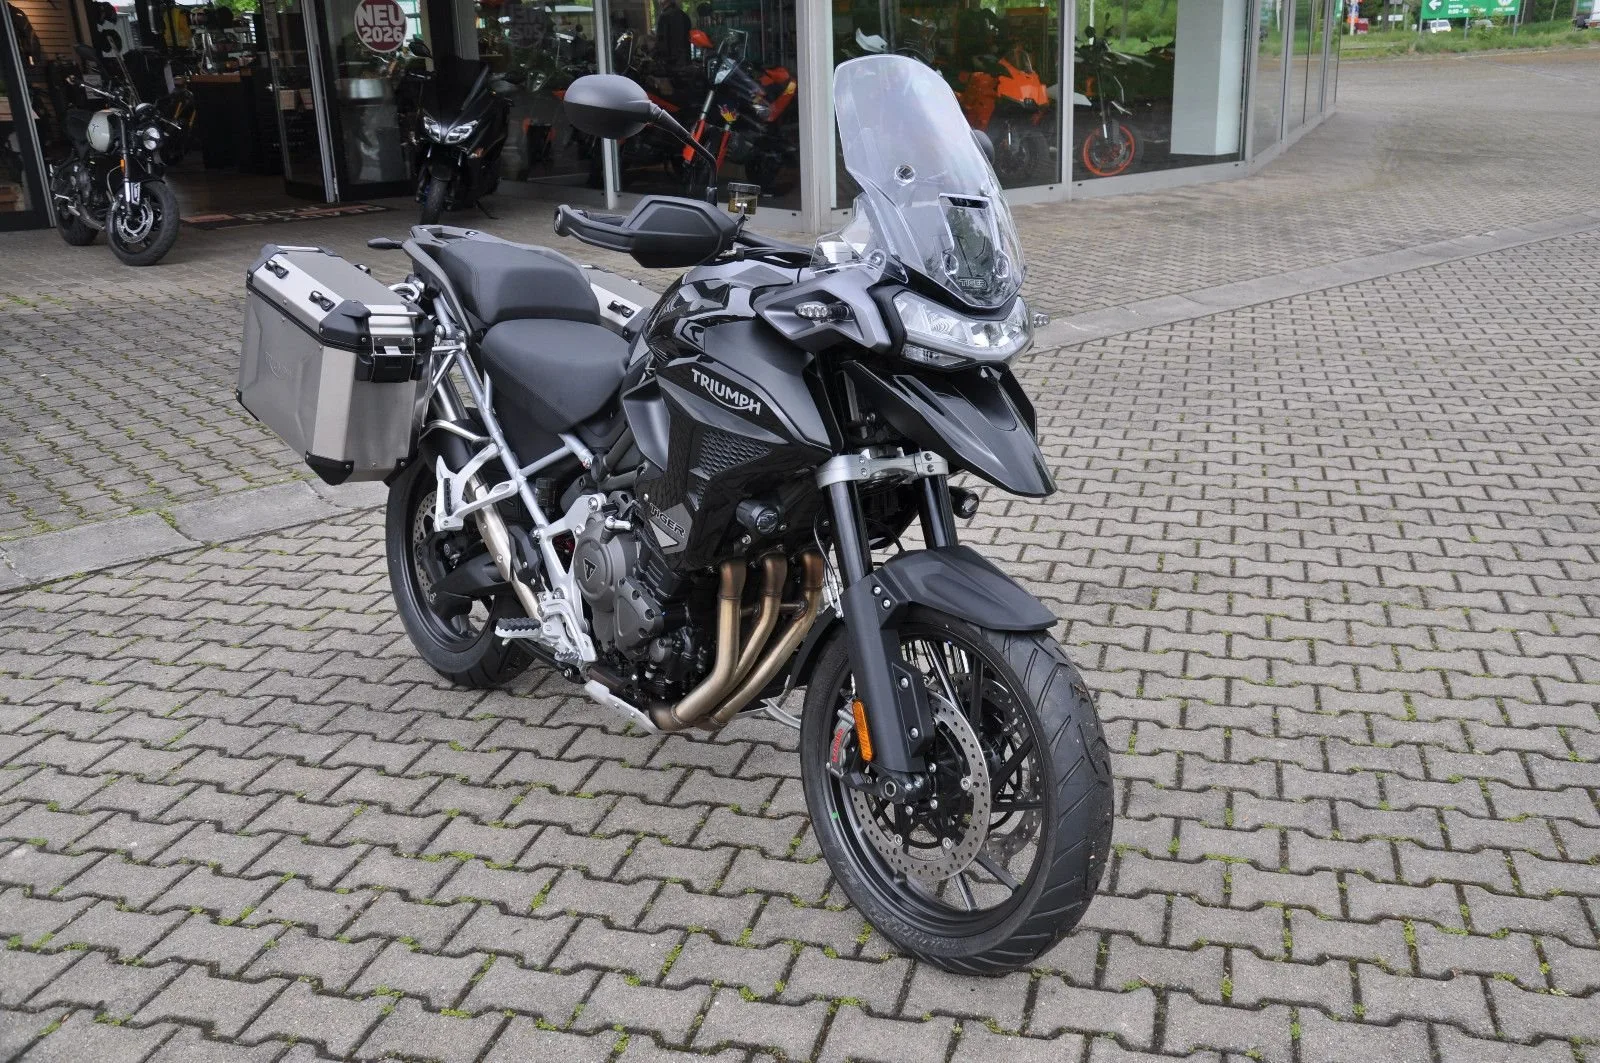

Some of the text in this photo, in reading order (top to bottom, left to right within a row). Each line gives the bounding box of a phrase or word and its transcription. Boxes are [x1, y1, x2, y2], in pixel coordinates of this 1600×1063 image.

[357, 4, 405, 26] NEU
[361, 26, 404, 42] 2026
[691, 368, 761, 416] TRIUMPH
[650, 502, 686, 538] TIGER
